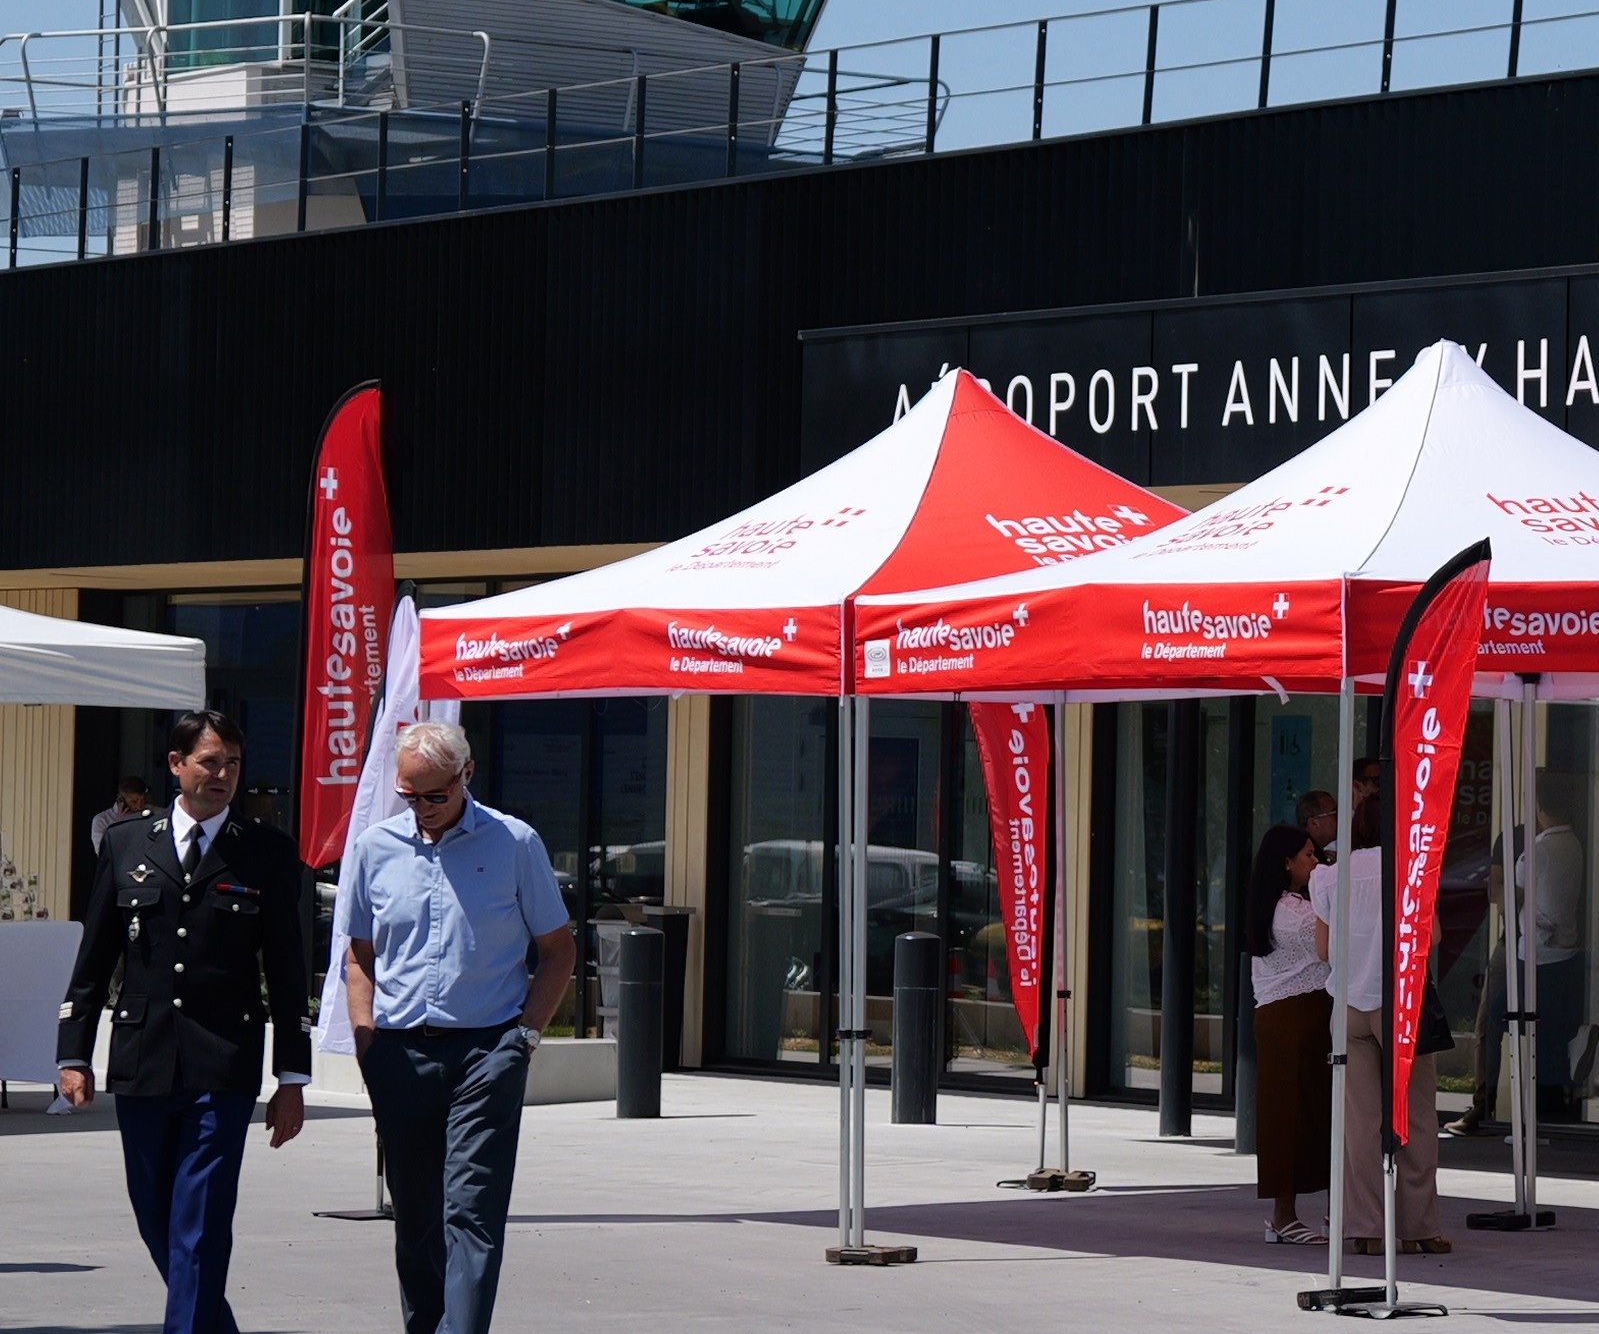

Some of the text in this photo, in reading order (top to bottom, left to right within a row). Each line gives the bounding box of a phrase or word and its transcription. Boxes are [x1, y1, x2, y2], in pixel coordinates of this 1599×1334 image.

[892, 362, 1198, 436] AOPORT
[1222, 343, 1487, 427] ANNE
[719, 514, 815, 540] haute
[986, 509, 1123, 539] haute
[691, 538, 796, 558] savoie
[1542, 536, 1565, 547] le
[1141, 643, 1226, 660] le Département
[1477, 639, 1546, 655] artement
[454, 663, 525, 683] le Département
[669, 656, 743, 675] le Département
[897, 657, 907, 674] le
[909, 654, 974, 674] Département
